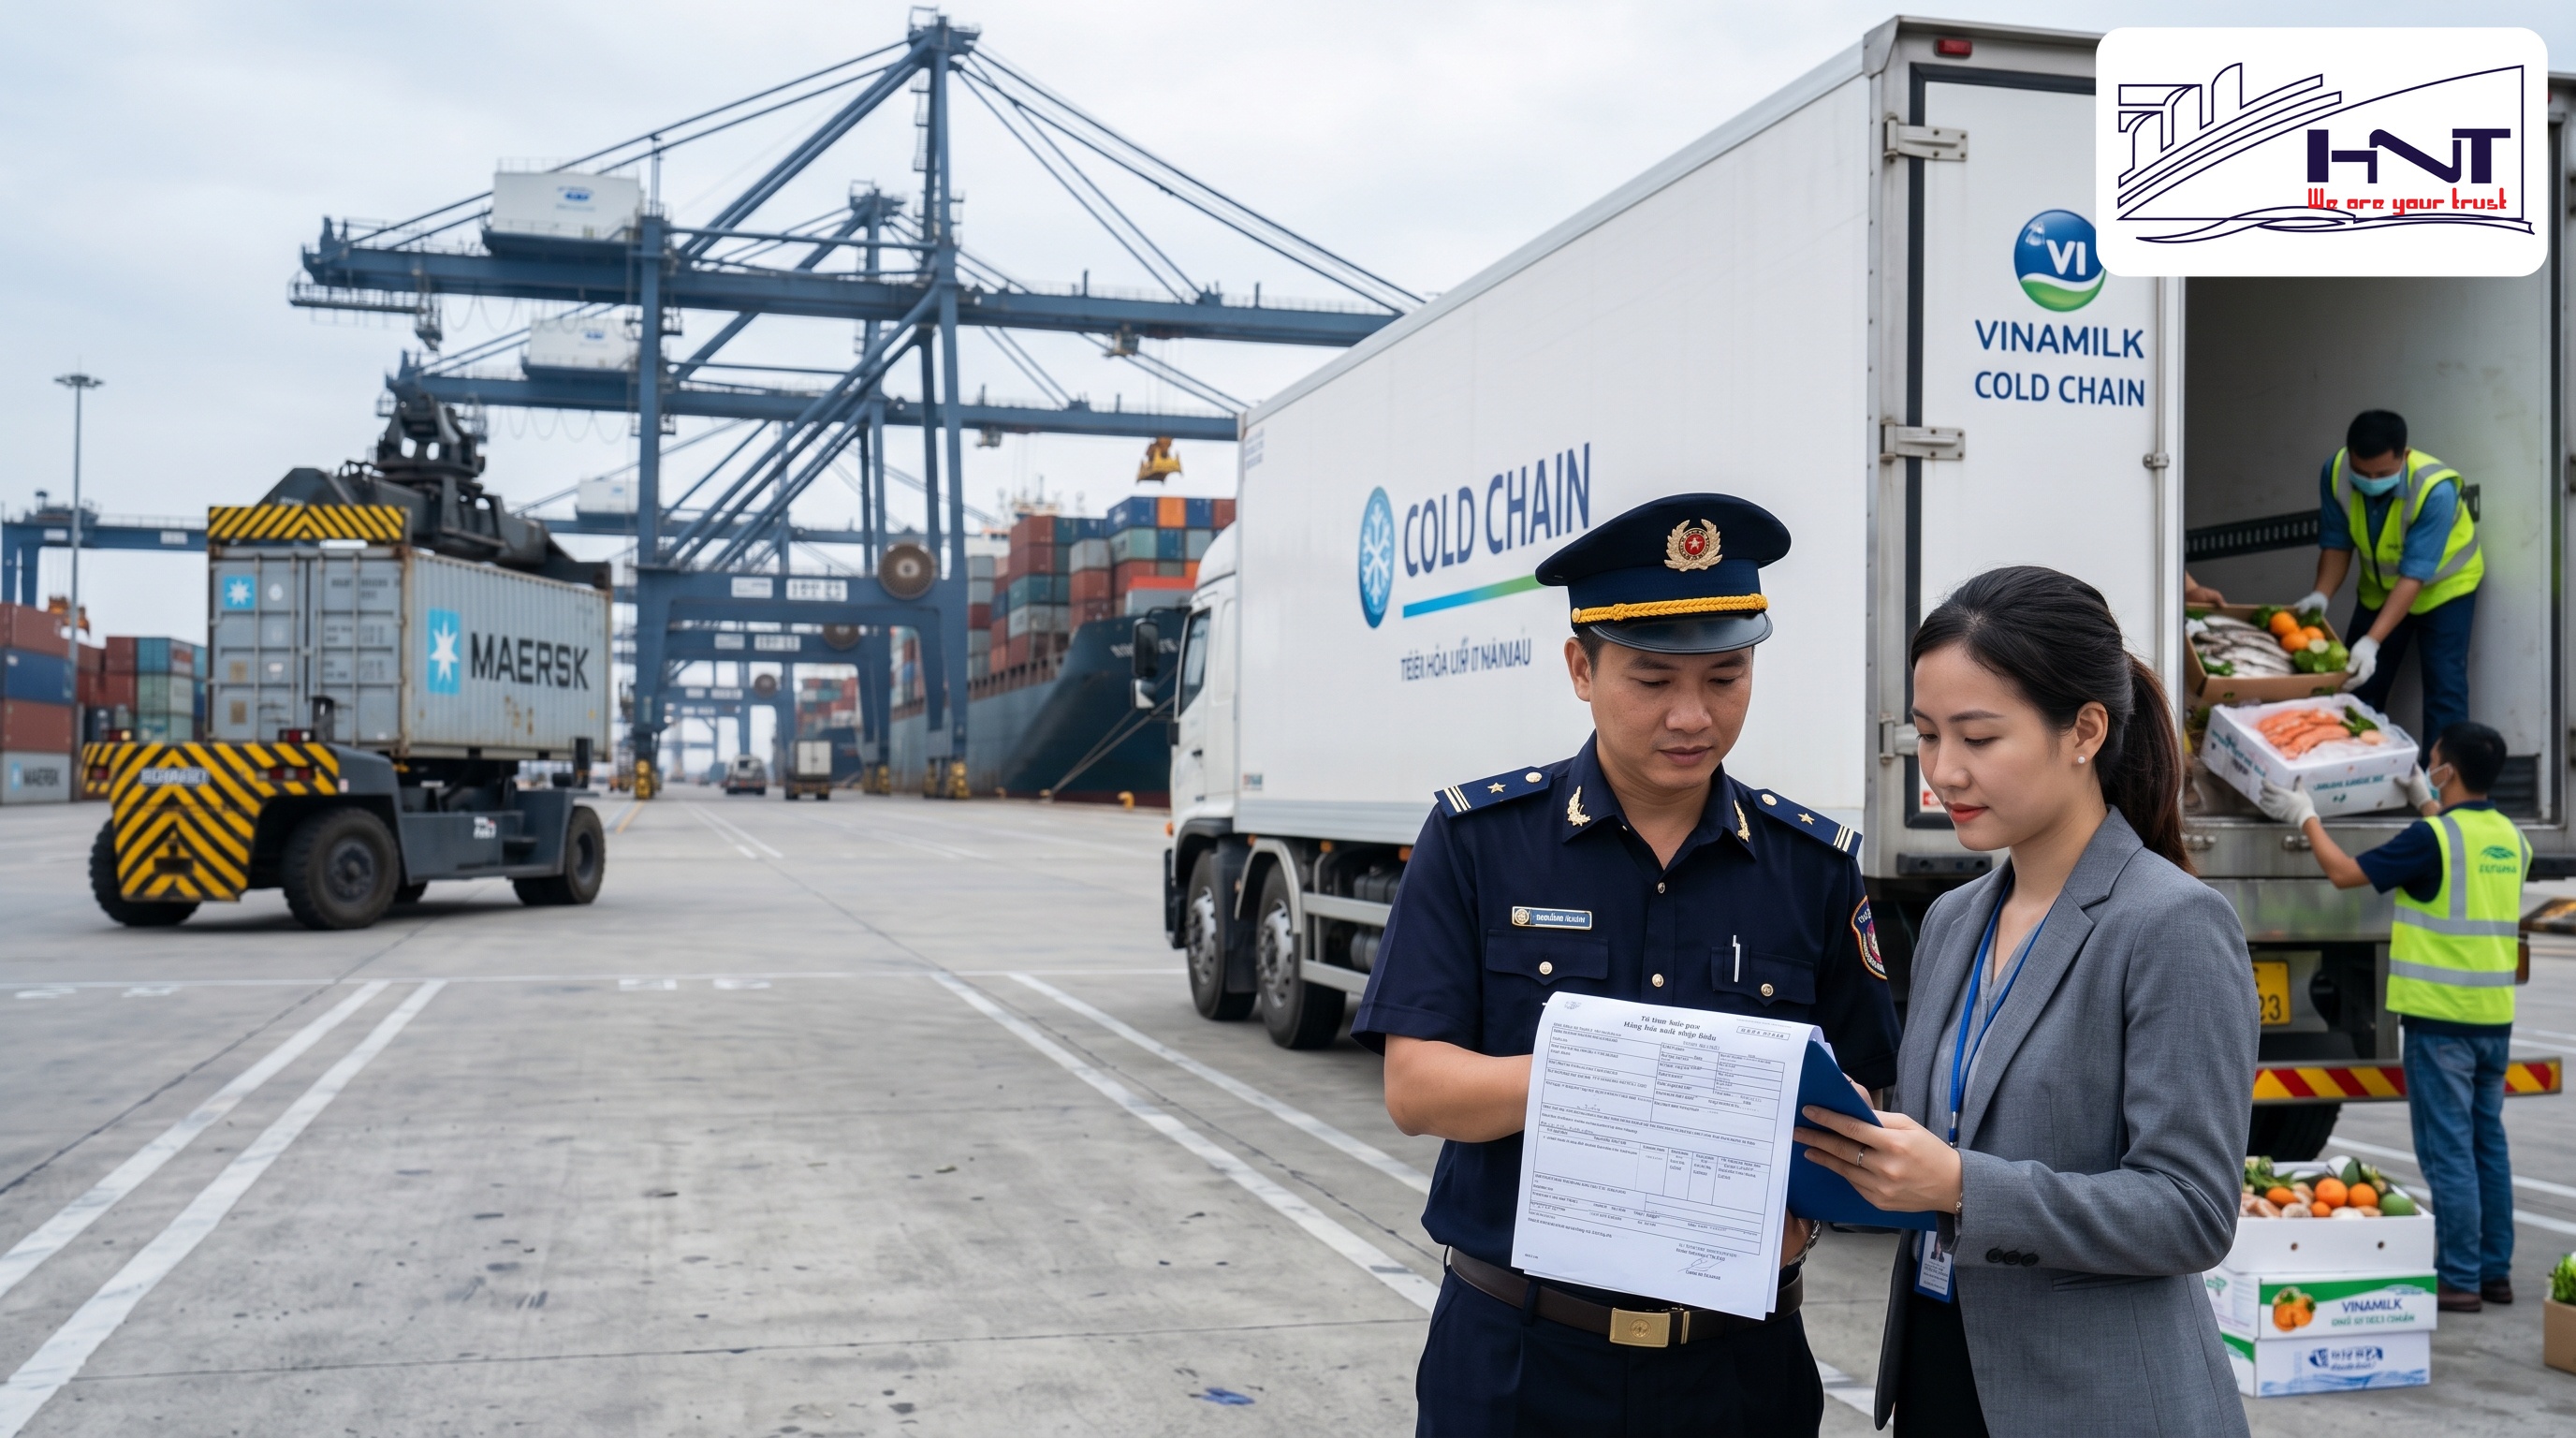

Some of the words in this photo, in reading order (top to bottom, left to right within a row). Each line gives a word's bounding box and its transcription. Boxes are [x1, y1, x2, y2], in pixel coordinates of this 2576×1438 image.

[2045, 239, 2086, 275] VI
[1974, 319, 2144, 359] VINAMILK
[1974, 371, 2049, 402] COLD
[2058, 375, 2144, 406] CHAIN
[1404, 486, 1475, 578] COLD
[1486, 442, 1590, 555] CHAIN
[471, 631, 589, 691] MAERSK
[2342, 1299, 2403, 1313] VINAMILK
